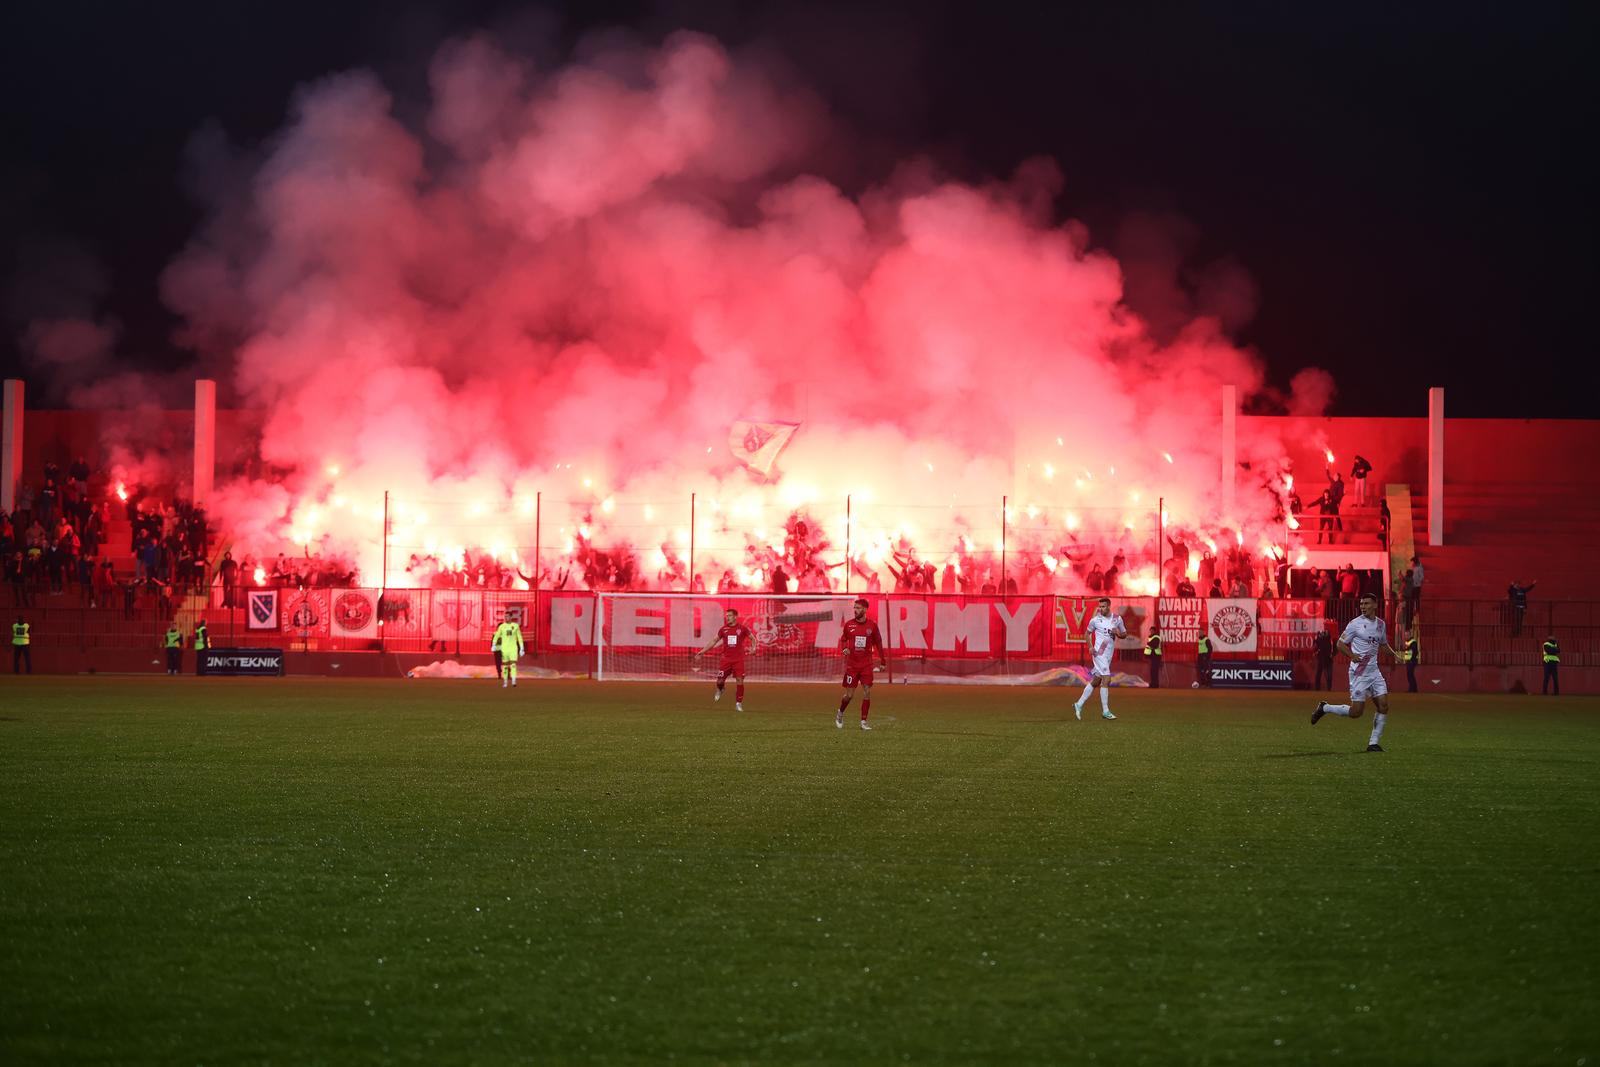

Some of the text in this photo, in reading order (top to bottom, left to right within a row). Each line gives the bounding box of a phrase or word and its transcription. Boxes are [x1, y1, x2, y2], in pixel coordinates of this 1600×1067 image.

[1158, 598, 1202, 612] AVANTI
[1264, 600, 1321, 617] VFC
[550, 597, 1043, 653] RED ARMY
[1158, 612, 1200, 628] VELEŽ
[1277, 619, 1309, 632] THE
[1263, 635, 1317, 649] RELIGIO
[1211, 668, 1292, 681] ZINKTEKNIK
